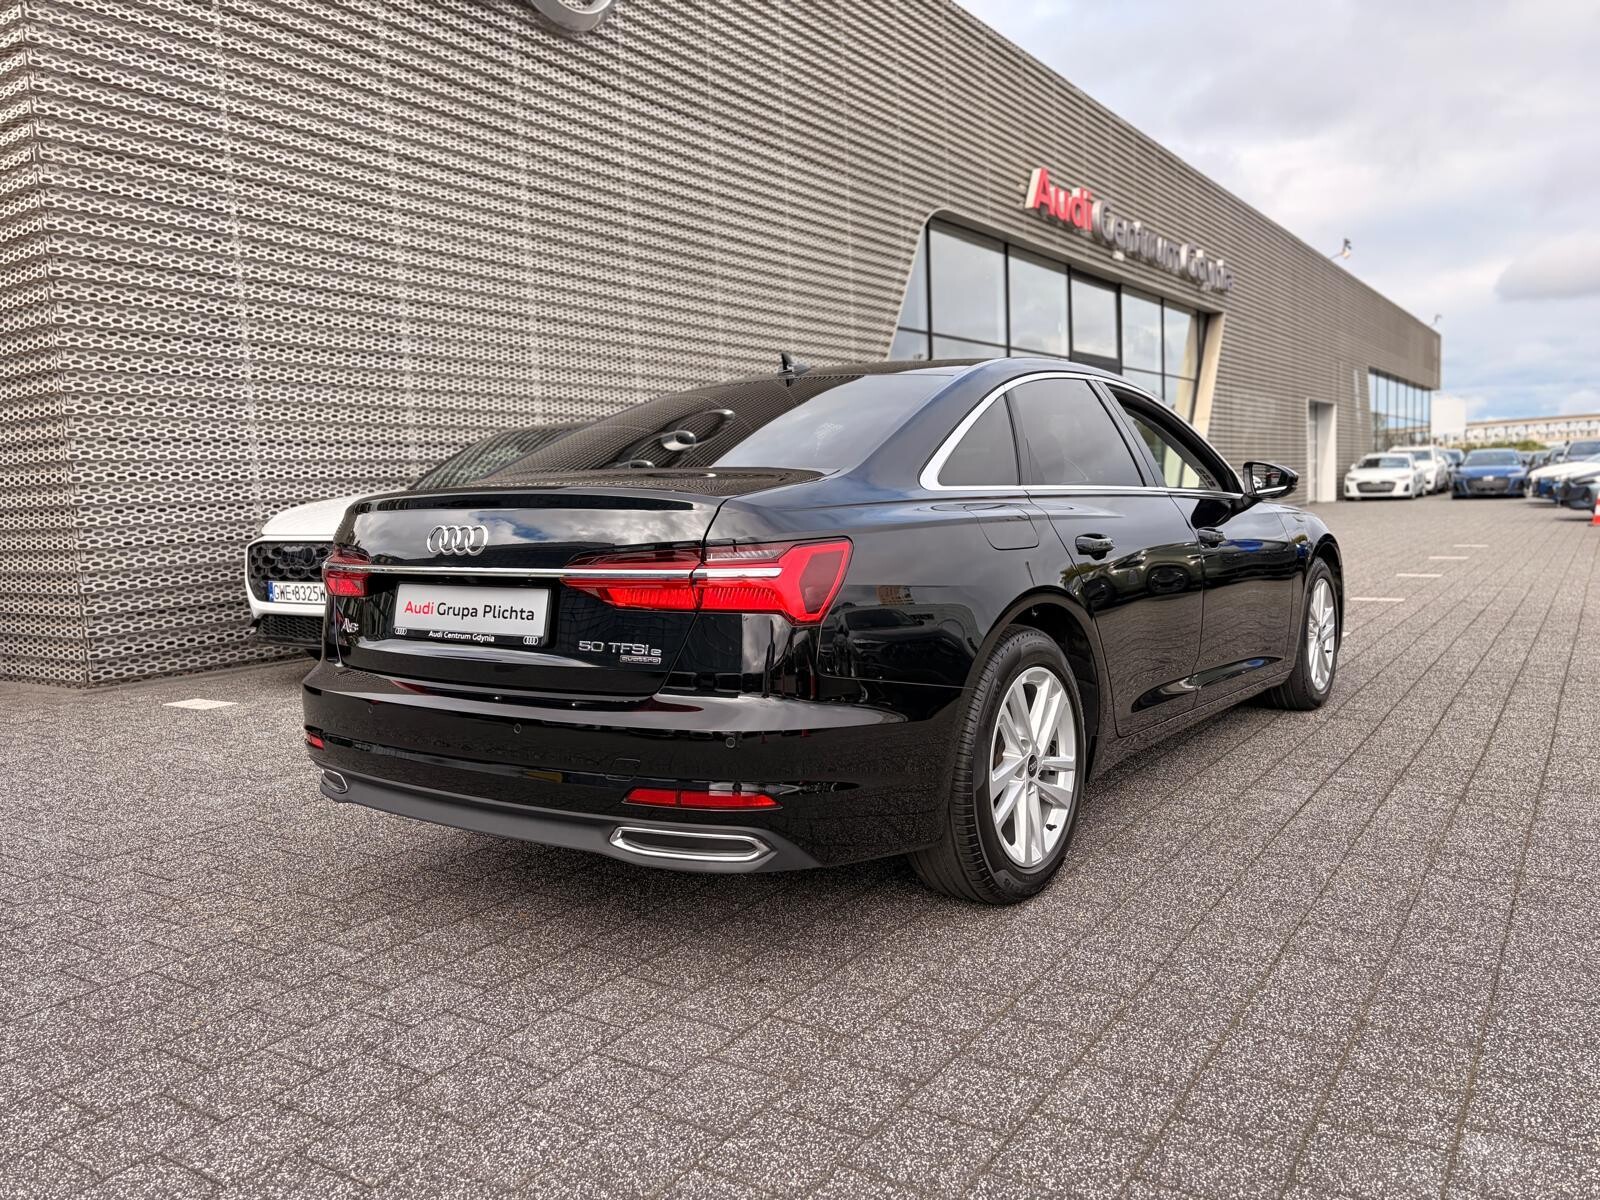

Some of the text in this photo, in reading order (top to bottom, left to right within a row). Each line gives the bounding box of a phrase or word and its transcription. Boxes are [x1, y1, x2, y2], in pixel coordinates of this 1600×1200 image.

[1026, 168, 1234, 294] Audi Centrum Gdynia
[274, 584, 292, 600] GWE
[404, 600, 535, 621] Audi Grupa Plichta
[428, 630, 495, 643] Audi Centrum Gdynia
[578, 640, 604, 652] 50
